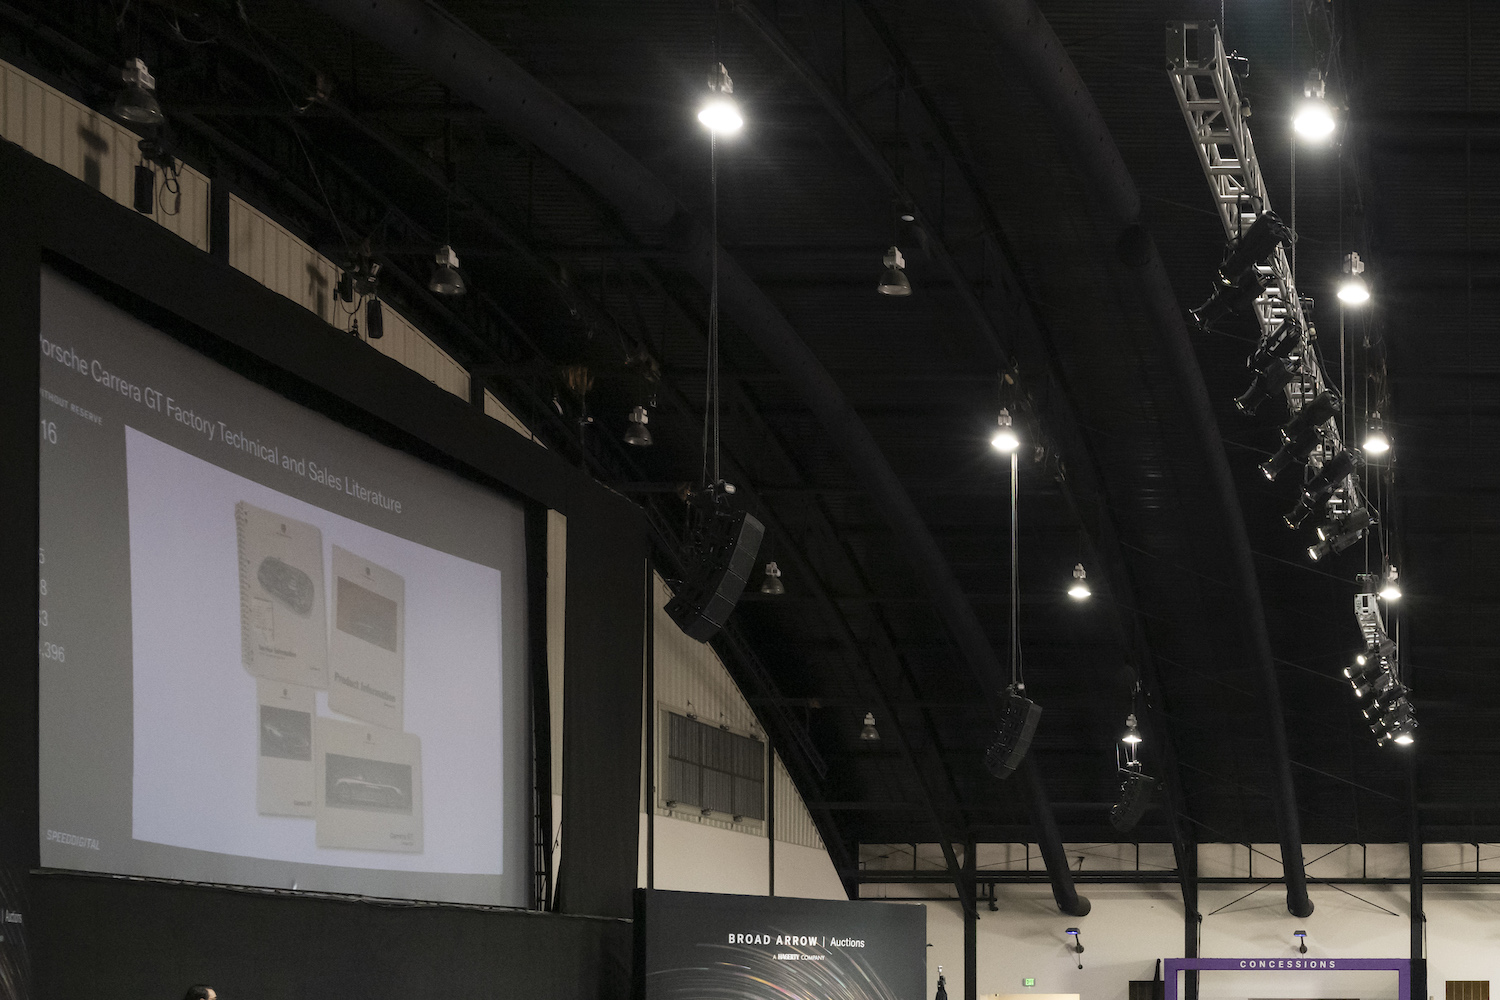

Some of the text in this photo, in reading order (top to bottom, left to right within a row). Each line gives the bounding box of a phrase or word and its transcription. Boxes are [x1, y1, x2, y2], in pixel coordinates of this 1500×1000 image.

[70, 403, 103, 426] RESERVE
[91, 359, 142, 403] Carrera
[144, 386, 163, 413] GT
[166, 397, 216, 442] Factory
[218, 421, 279, 466] Technical
[282, 454, 306, 478] and
[309, 461, 343, 492] Sales
[345, 476, 403, 514] Literature
[46, 828, 101, 851] SPEEDDIGITAL
[728, 933, 866, 948] BROAD ARROW Auctions
[1239, 960, 1336, 969] CONCESSIONS
